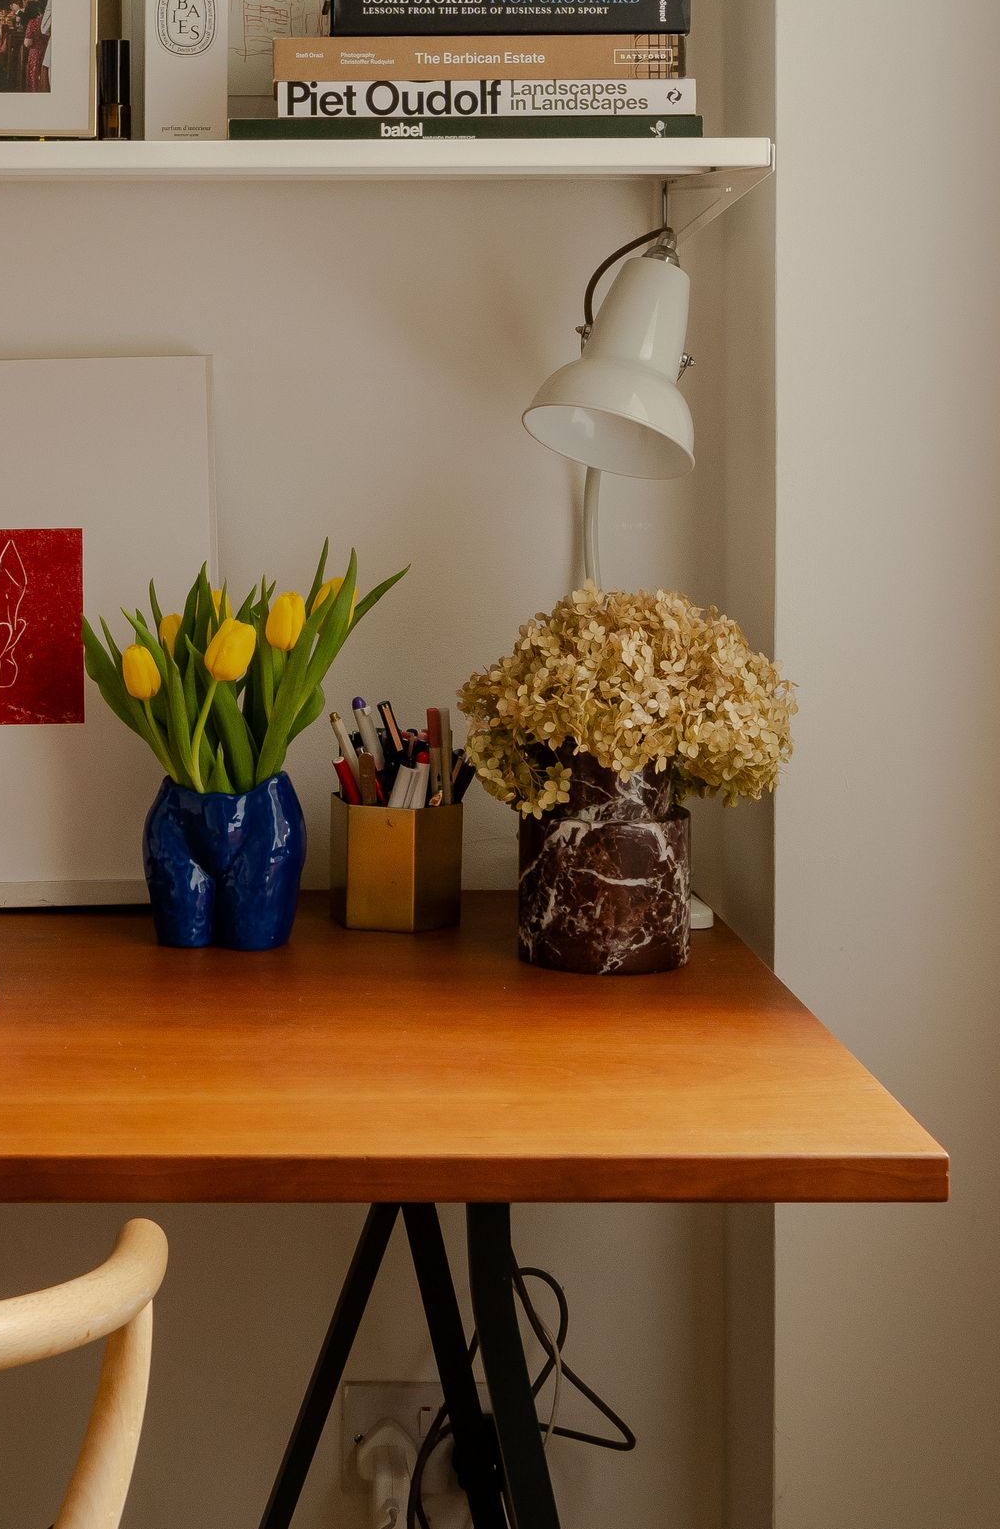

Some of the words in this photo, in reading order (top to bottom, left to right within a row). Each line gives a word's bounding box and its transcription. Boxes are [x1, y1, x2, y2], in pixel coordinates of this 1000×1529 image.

[414, 52, 440, 65] The
[443, 51, 501, 65] Barbican
[504, 52, 545, 65] Estate
[287, 81, 357, 116] Piet
[365, 81, 501, 116] Oudolf
[509, 81, 628, 99] Landscapes
[510, 97, 527, 112] in
[531, 96, 648, 113] Landscapes
[380, 123, 423, 138] babel
